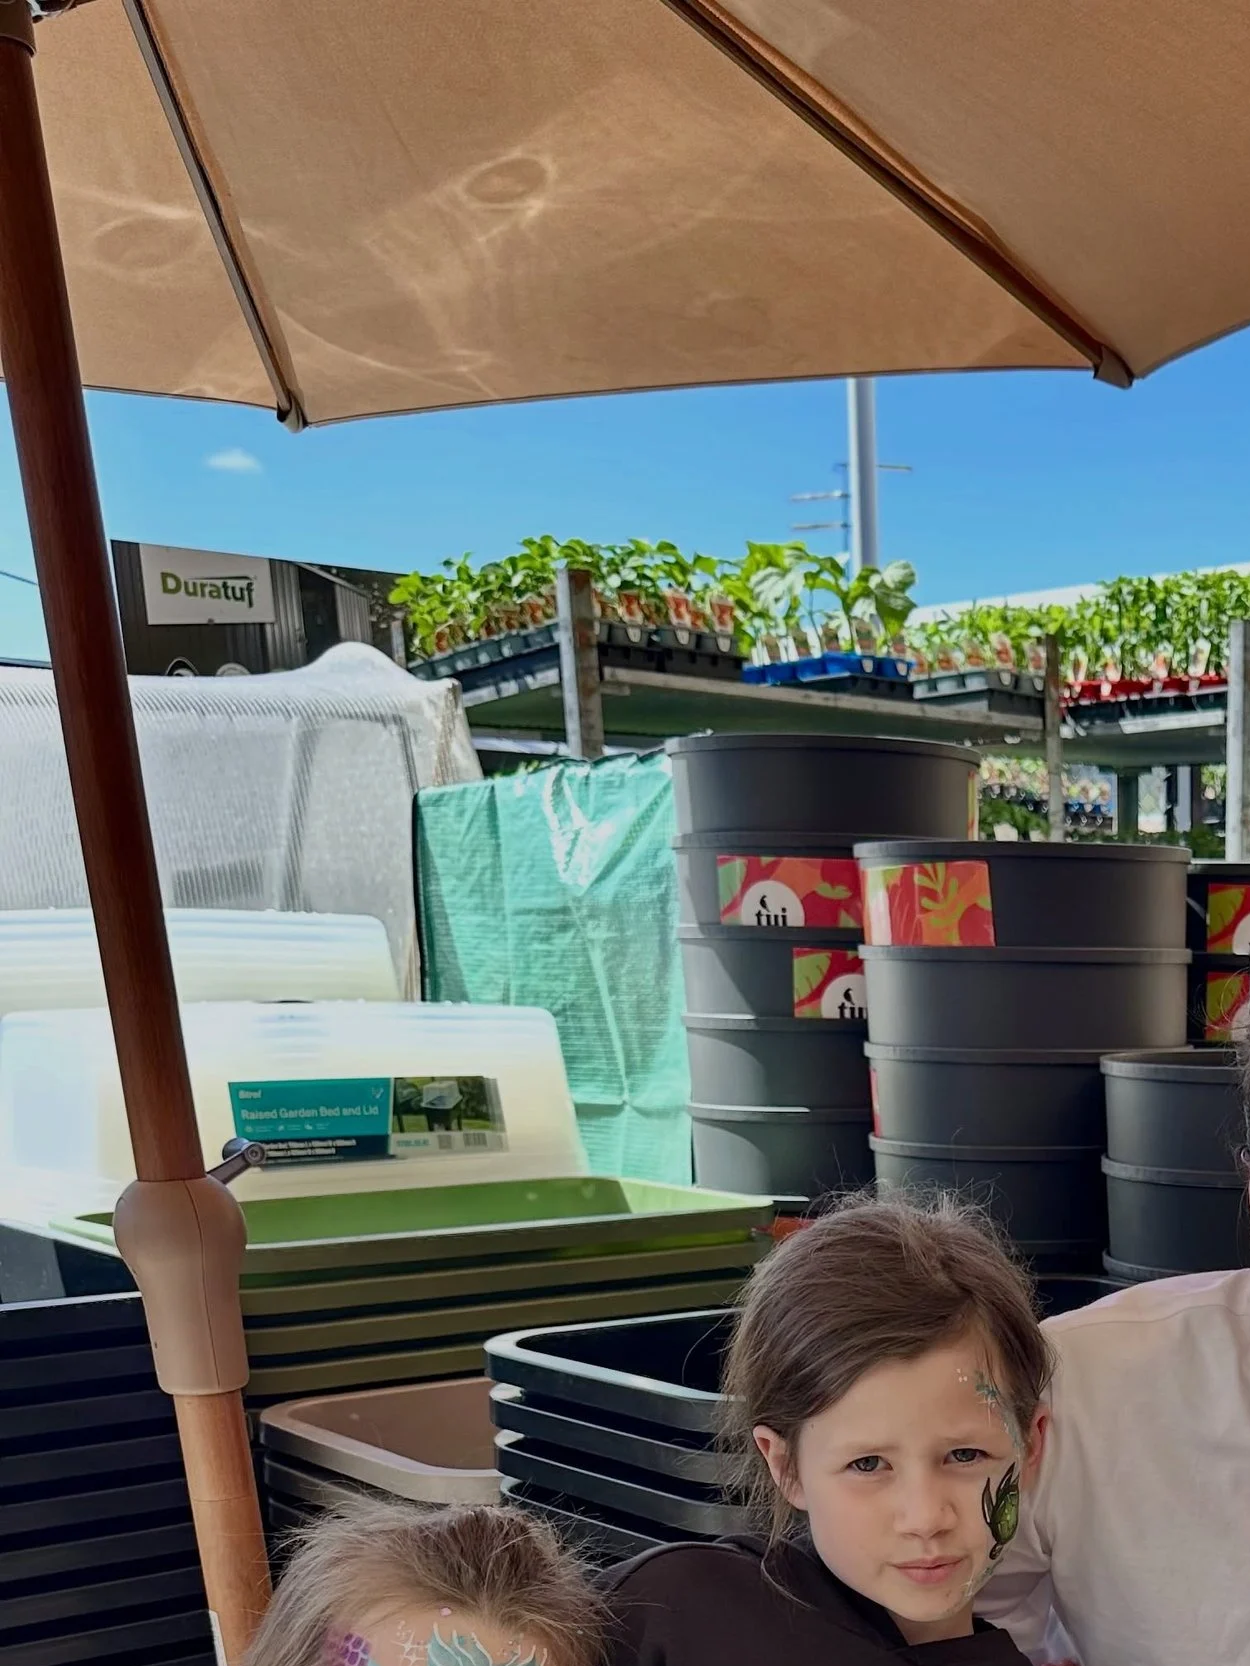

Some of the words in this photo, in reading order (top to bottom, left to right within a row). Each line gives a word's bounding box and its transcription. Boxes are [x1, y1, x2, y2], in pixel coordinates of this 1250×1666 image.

[160, 571, 255, 609] Duratuf
[755, 906, 788, 926] tui
[240, 1109, 278, 1120] Raised
[279, 1107, 318, 1119] Garden
[319, 1105, 340, 1117] Bed
[342, 1106, 361, 1116] and
[362, 1105, 379, 1115] Lid
